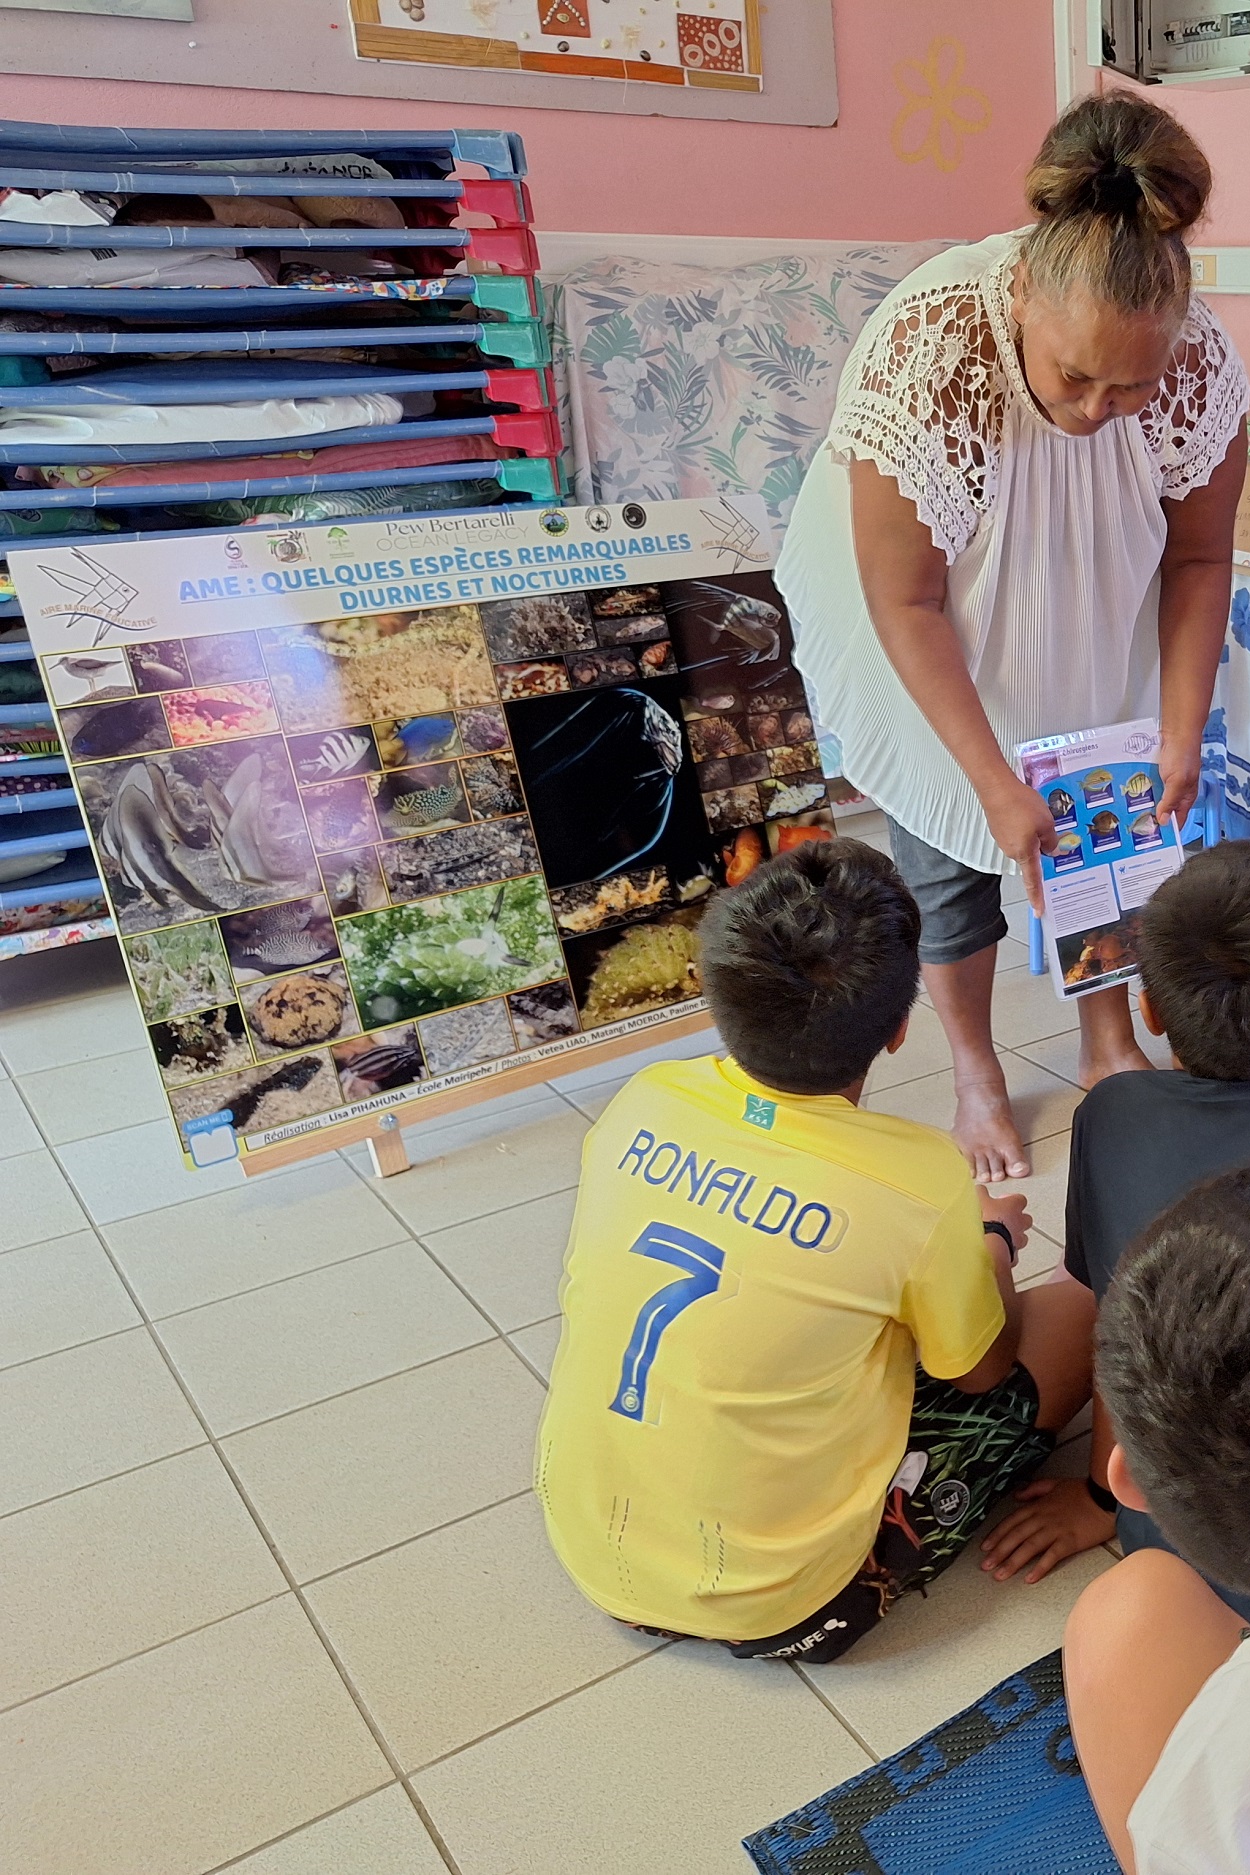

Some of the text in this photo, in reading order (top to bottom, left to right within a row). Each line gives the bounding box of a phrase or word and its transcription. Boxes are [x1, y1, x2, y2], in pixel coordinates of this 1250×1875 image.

[376, 532, 449, 552] OCEAN
[454, 526, 529, 546] LEGACY
[385, 512, 515, 536] Pew Bertarelli
[180, 576, 241, 601] AME
[261, 560, 404, 594] QUELQUES
[410, 547, 512, 576] ESPÈCES
[518, 533, 691, 565] REMARQUABLES
[339, 563, 627, 610] DIURNES ET NOCTURNES
[40, 604, 62, 616] AIRE
[263, 1119, 321, 1145] Réalisation
[329, 1110, 349, 1123] Lisa
[351, 1092, 407, 1117] PIHAHUNA
[417, 1081, 442, 1096] École
[501, 1054, 532, 1071] Photos
[538, 1043, 564, 1057] Vetea
[591, 1025, 627, 1041] Matangi
[669, 1001, 699, 1016] Pauline
[618, 1129, 831, 1249] RONALDO
[608, 1221, 726, 1422] 7
